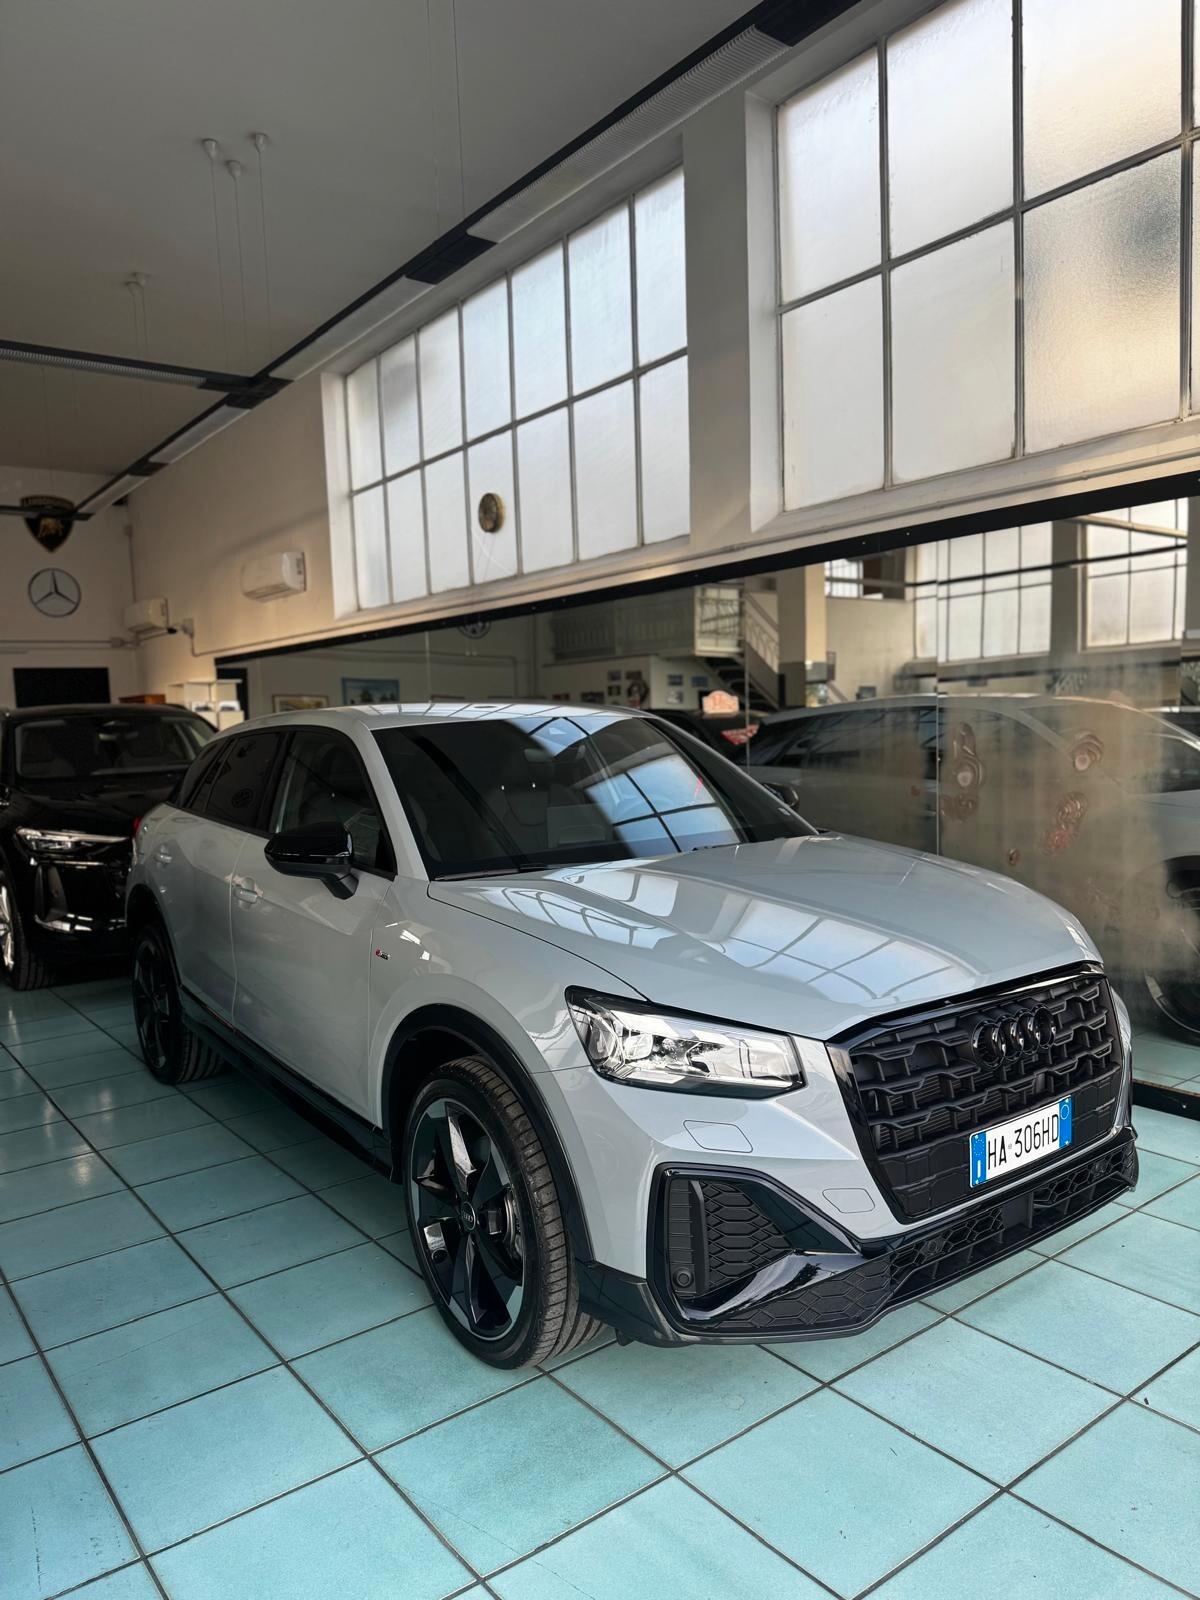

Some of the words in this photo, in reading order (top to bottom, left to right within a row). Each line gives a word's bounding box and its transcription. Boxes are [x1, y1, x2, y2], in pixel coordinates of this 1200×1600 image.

[988, 1135, 1007, 1170] HA
[1014, 1113, 1059, 1158] 306HD
[977, 1159, 982, 1178] I
